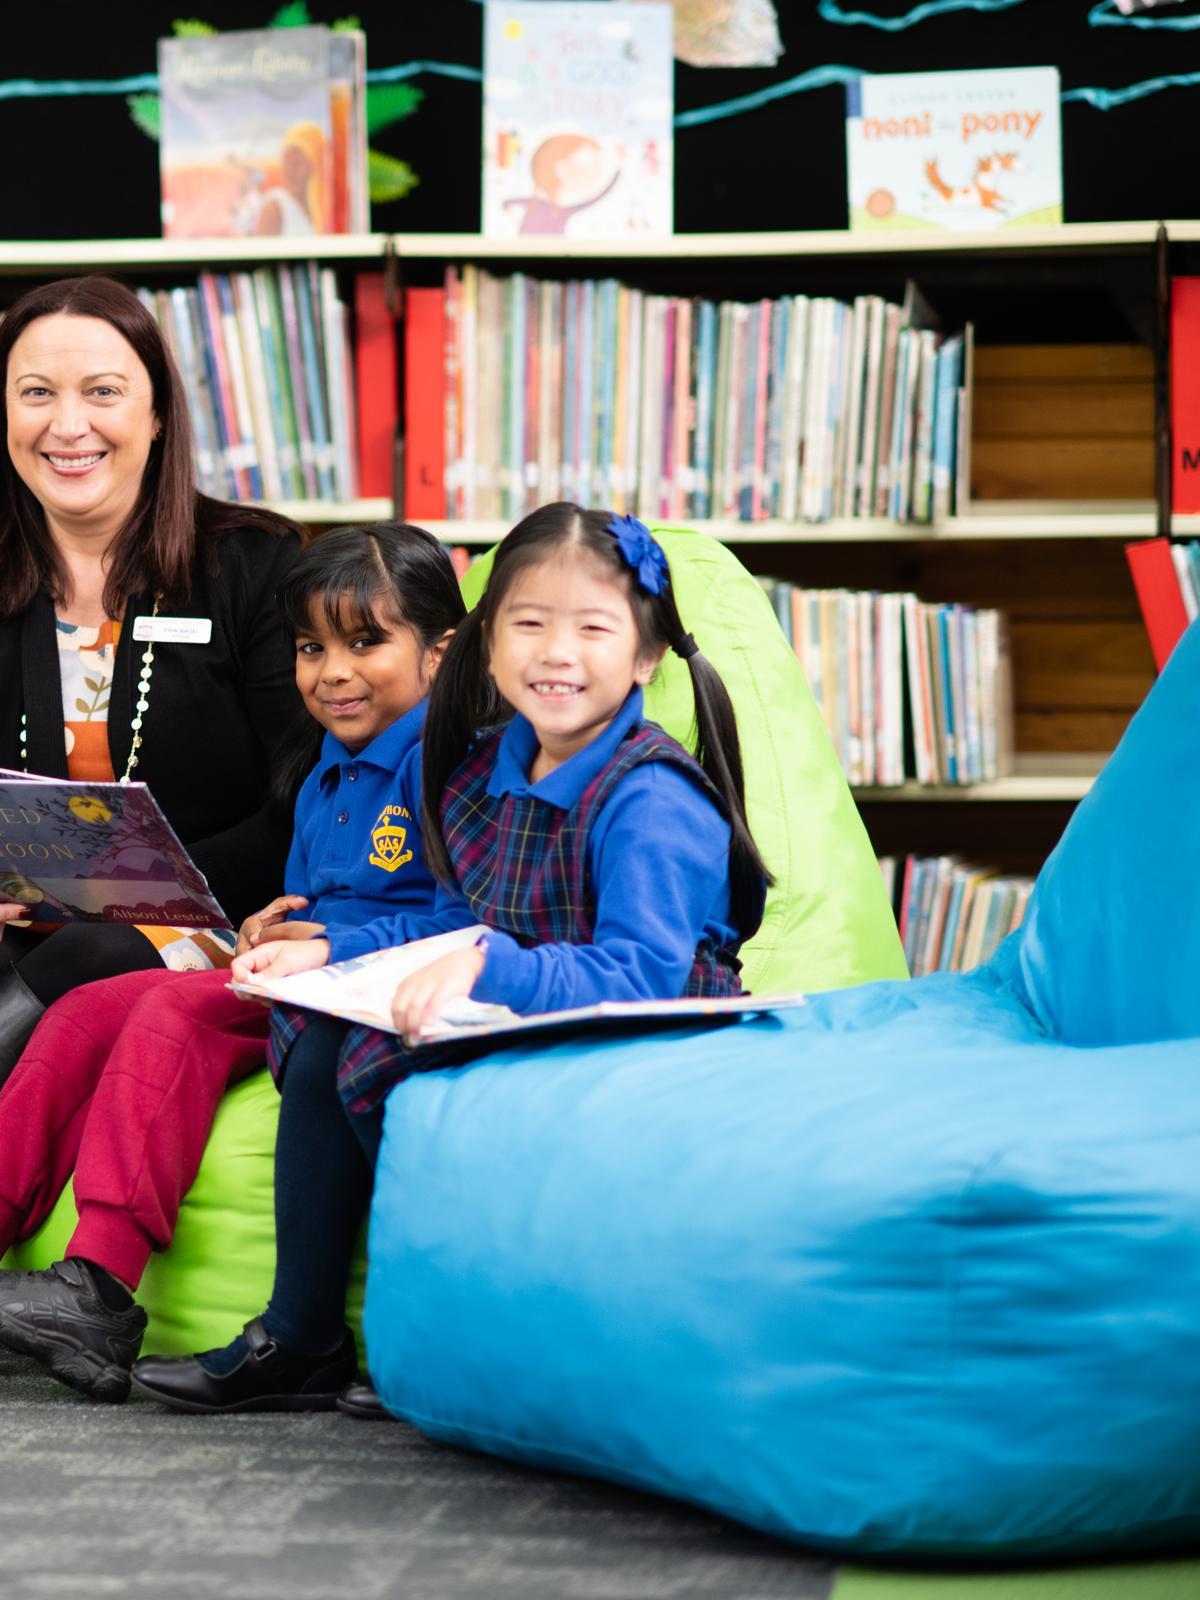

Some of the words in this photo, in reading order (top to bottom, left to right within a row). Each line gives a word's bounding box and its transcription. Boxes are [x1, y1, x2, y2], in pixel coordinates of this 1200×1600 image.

[862, 112, 932, 140] noni
[960, 110, 1043, 144] pony
[1182, 449, 1200, 470] M
[420, 463, 435, 488] L
[112, 909, 160, 920] Alison
[163, 911, 210, 922] Lester
